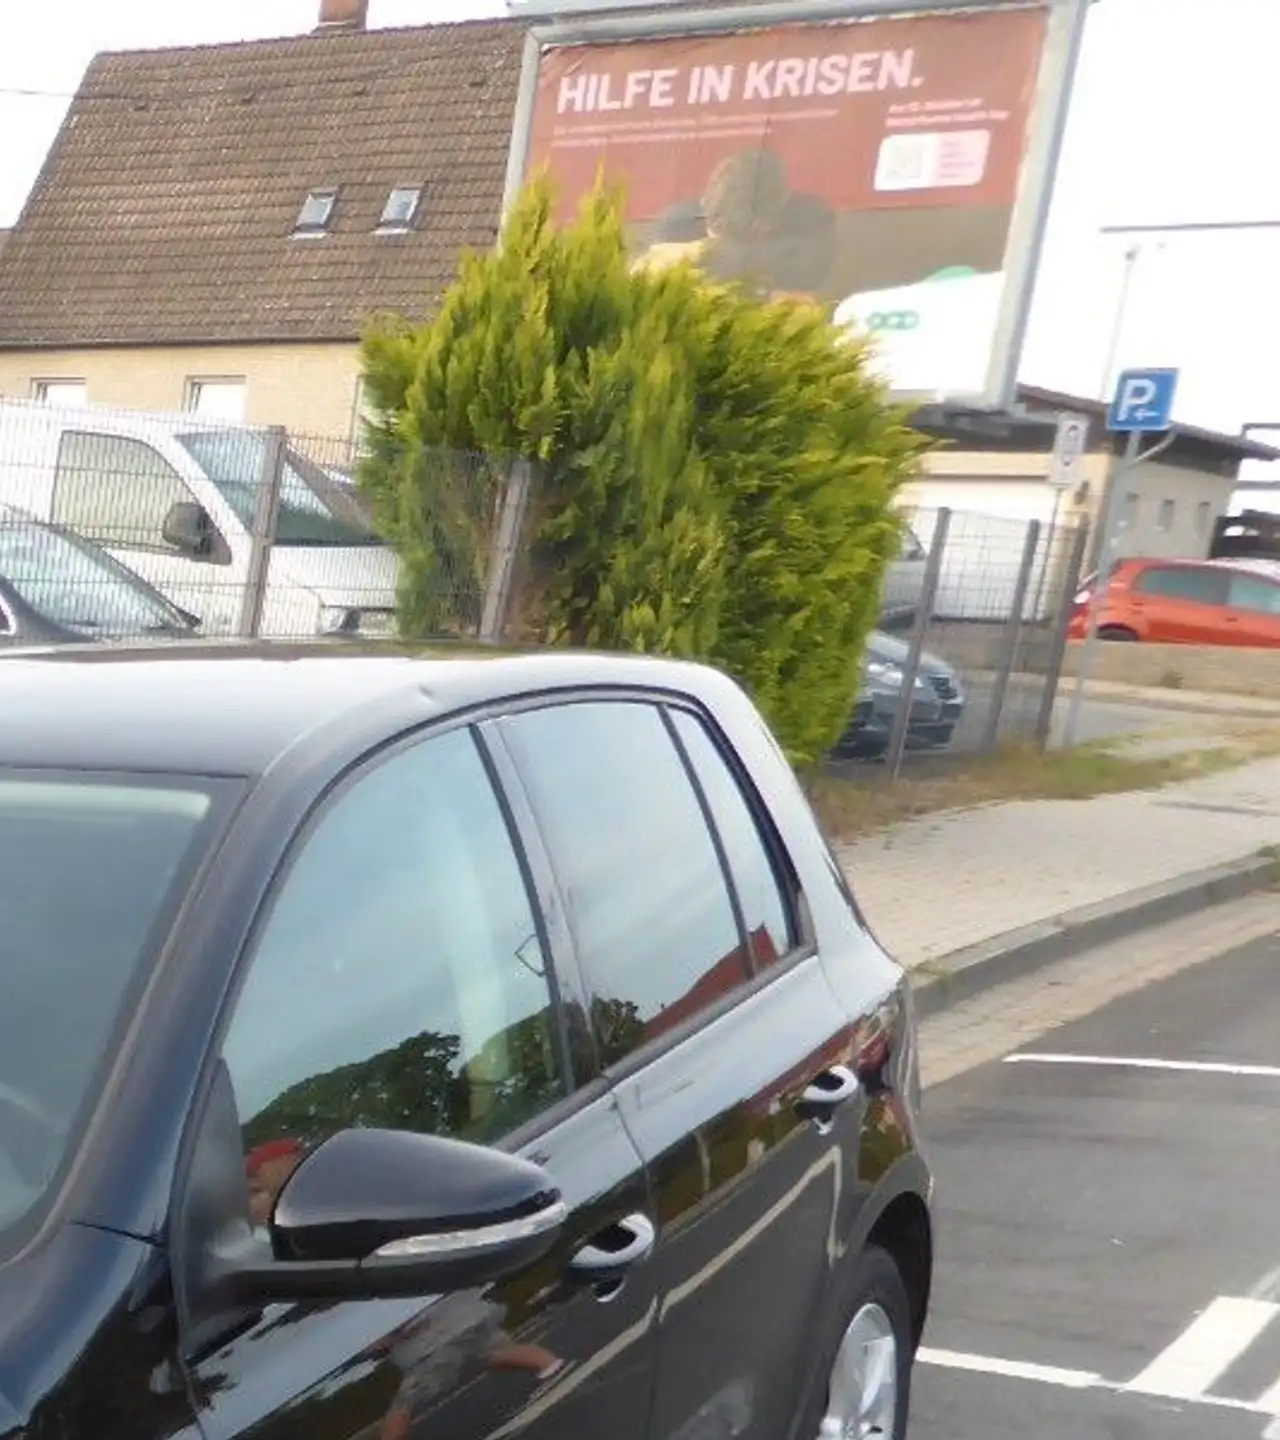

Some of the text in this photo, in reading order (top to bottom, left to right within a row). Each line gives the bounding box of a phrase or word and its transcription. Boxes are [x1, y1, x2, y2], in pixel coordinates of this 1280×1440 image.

[557, 48, 925, 114] HILFE IN KRISEN.
[1116, 378, 1157, 422] P
